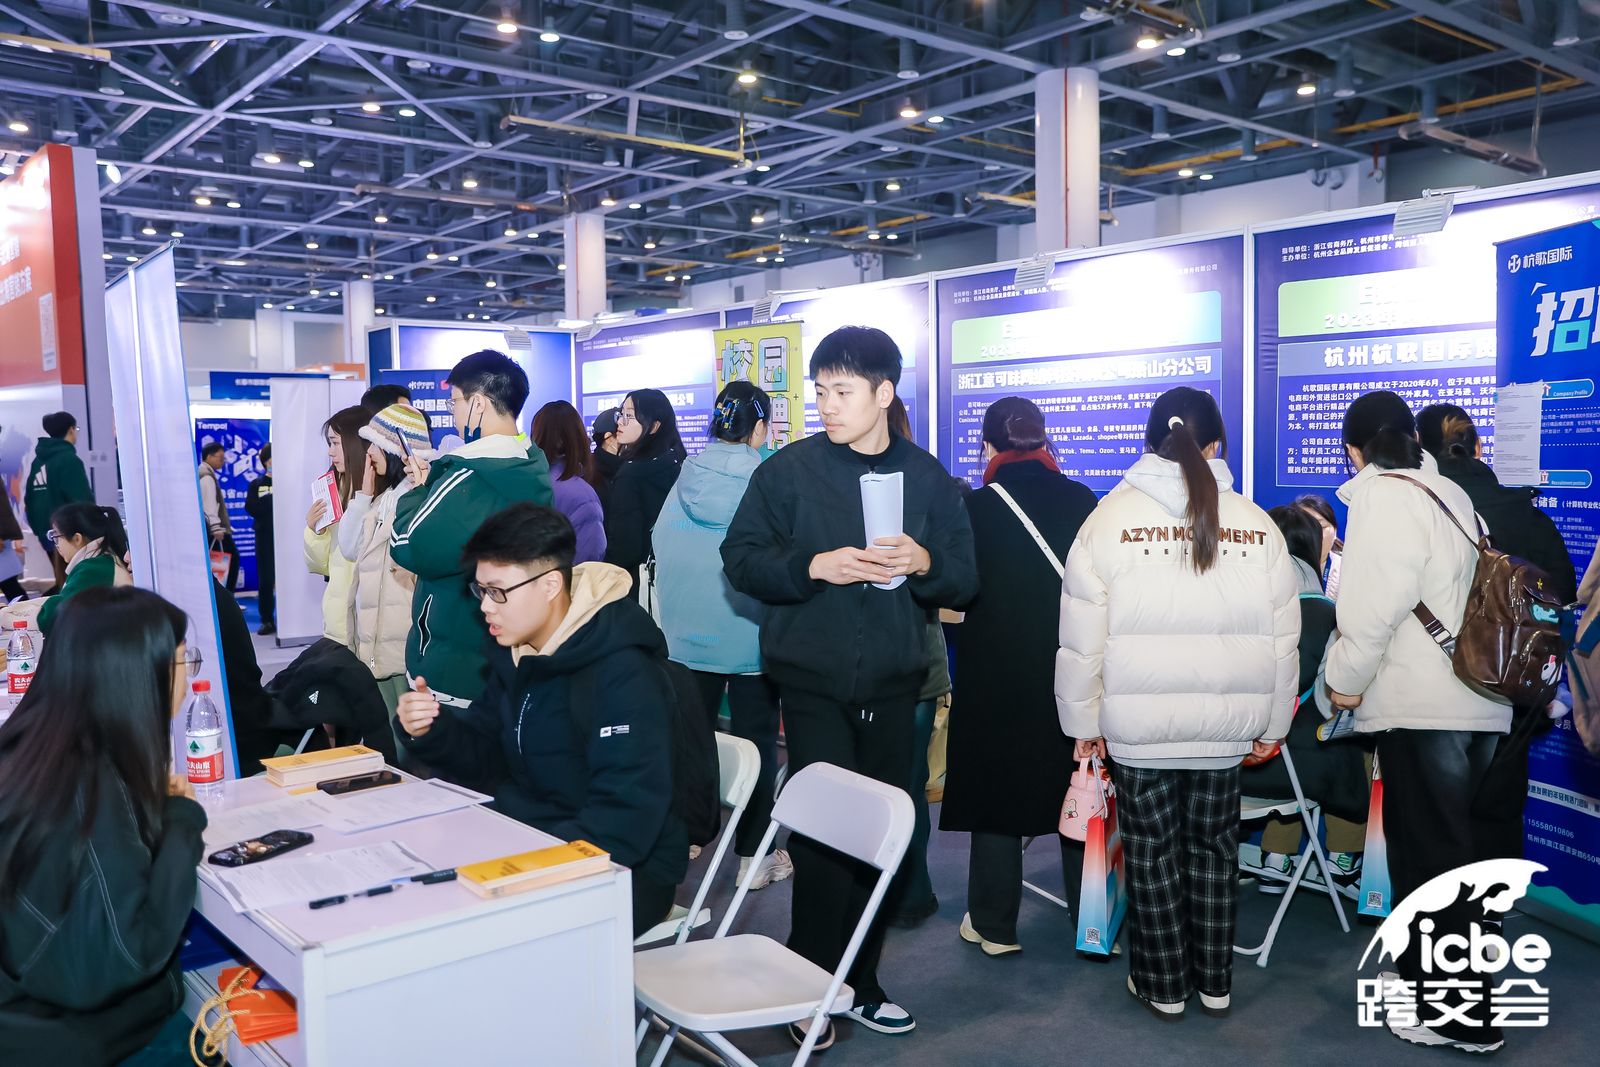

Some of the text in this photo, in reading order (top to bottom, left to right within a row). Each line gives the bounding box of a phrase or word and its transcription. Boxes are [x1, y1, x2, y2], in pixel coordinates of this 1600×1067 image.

[1523, 246, 1572, 269] 杭歌国际
[1530, 286, 1600, 357] 招
[720, 336, 790, 391] 校园
[1120, 526, 1267, 546] AZYN MOMENT
[1528, 818, 1575, 839] 15558010806
